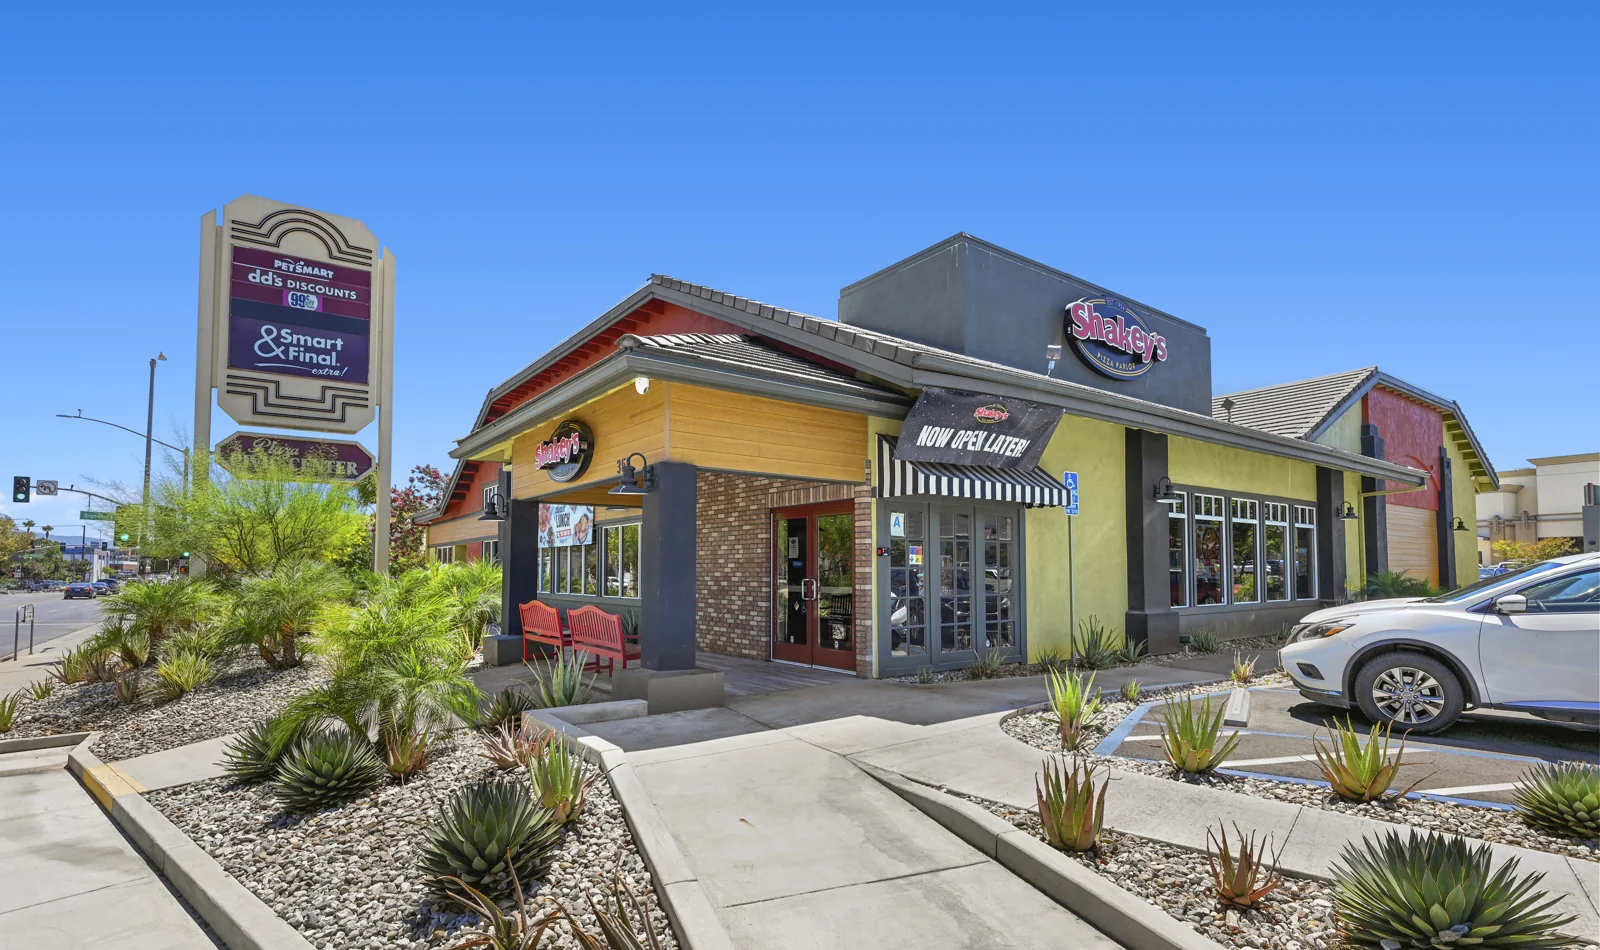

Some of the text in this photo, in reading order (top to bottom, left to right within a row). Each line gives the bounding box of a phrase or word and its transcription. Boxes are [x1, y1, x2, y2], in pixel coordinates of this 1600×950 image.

[248, 269, 357, 300] dd's DISCOUNTS
[274, 259, 334, 279] PETSMART
[254, 324, 344, 360] & Smart
[1070, 302, 1168, 363] Shakey's
[311, 366, 348, 377] extra!
[1097, 352, 1136, 371] PIZZA PARLOR
[535, 432, 580, 470] Shakey's
[916, 425, 1031, 458] NOW OPEN LATER!
[893, 516, 901, 528] A
